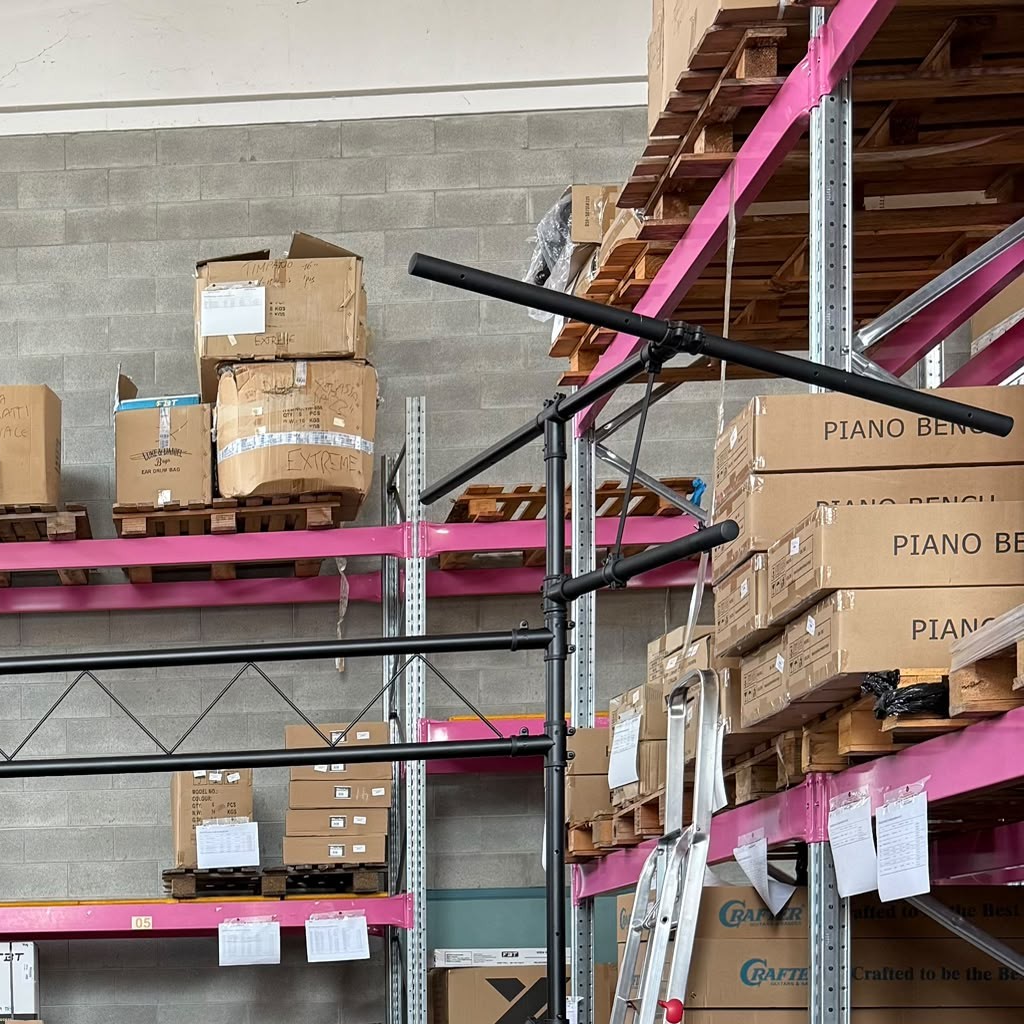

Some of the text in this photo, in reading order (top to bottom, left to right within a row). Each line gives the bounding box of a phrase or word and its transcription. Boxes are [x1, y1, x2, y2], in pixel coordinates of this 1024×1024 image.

[824, 417, 986, 441] PIANO BEN
[893, 533, 982, 556] PIANO
[912, 618, 995, 641] PIAN
[135, 918, 151, 928] 05
[740, 958, 808, 987] CRAFTE
[853, 966, 914, 981] Crafted
[920, 968, 935, 981] to
[941, 967, 961, 981] be
[966, 967, 993, 981] the
